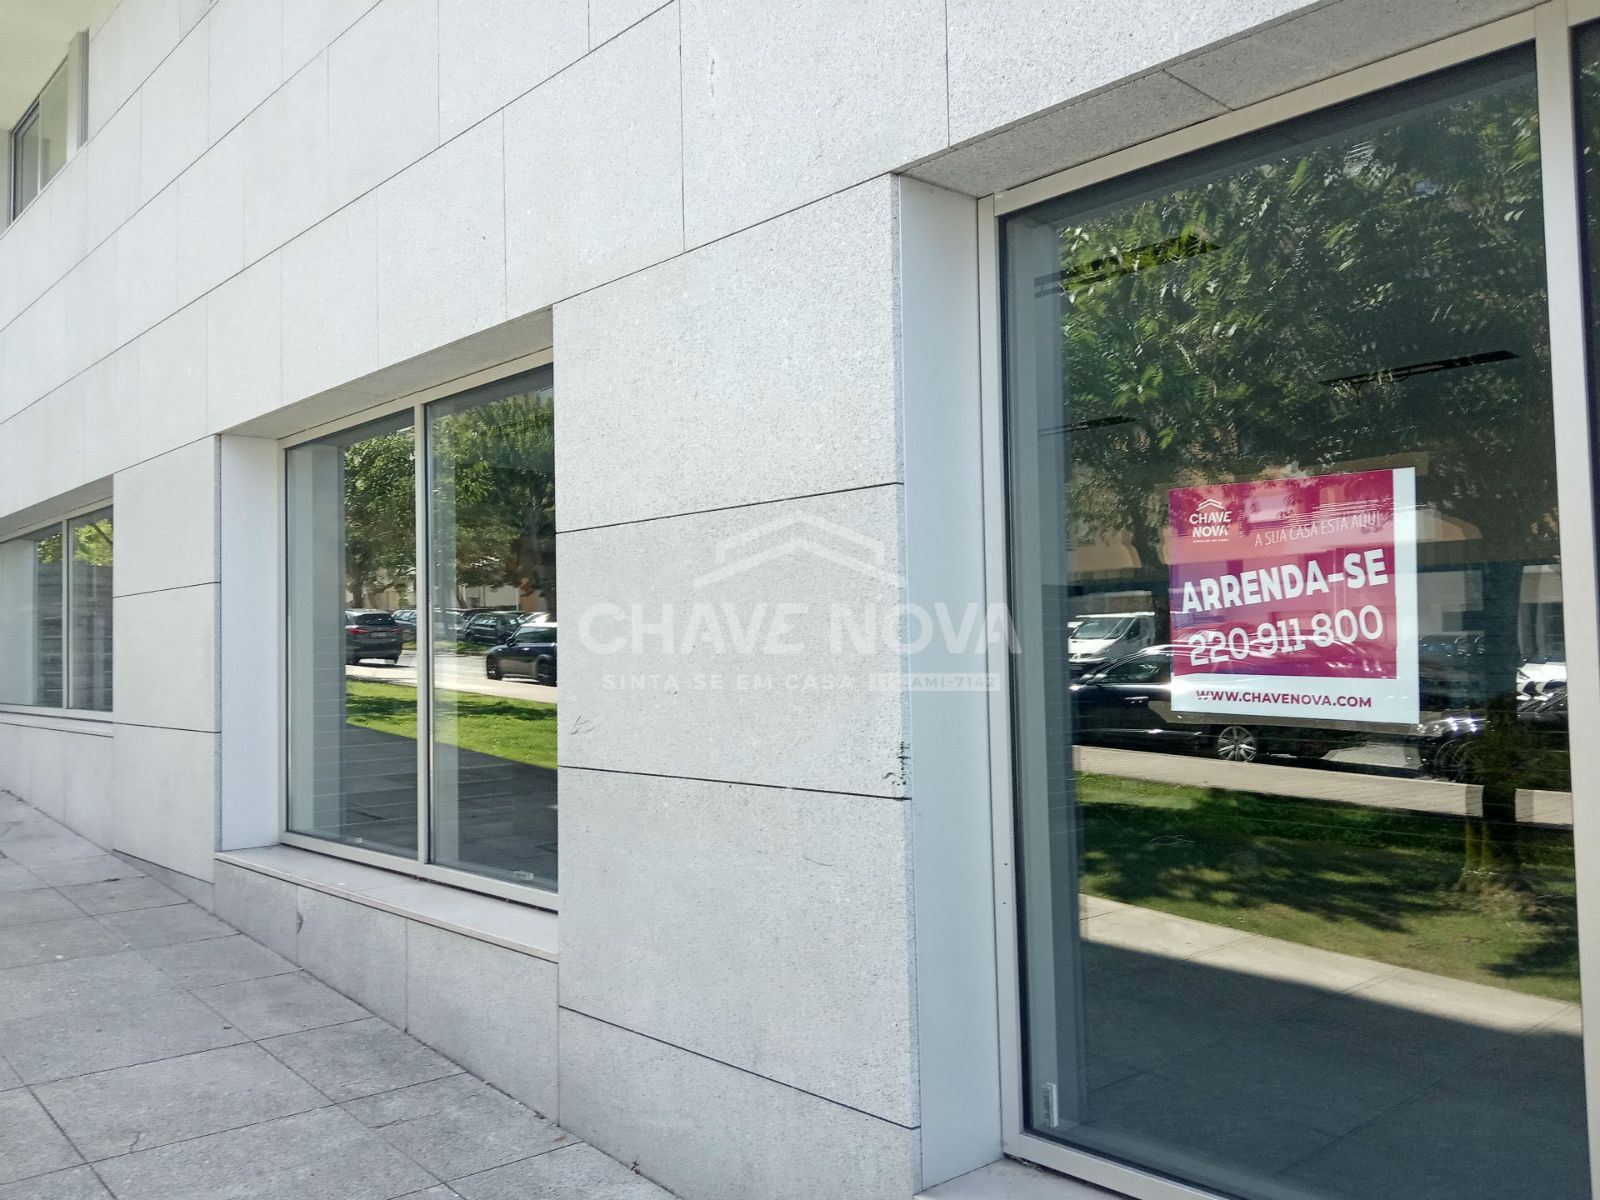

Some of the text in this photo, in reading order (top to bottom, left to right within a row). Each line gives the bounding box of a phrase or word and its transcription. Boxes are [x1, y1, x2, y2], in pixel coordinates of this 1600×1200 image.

[1189, 510, 1231, 524] CHAVE
[1192, 526, 1229, 538] NOVA
[1255, 534, 1262, 547] A
[1265, 529, 1287, 545] SUA
[1289, 522, 1318, 540] CASA
[1182, 549, 1389, 614] ARRENDA-SE
[1188, 605, 1383, 666] 220 911 800
[1196, 690, 1372, 708] WWW.CHAVENOVA.COM
